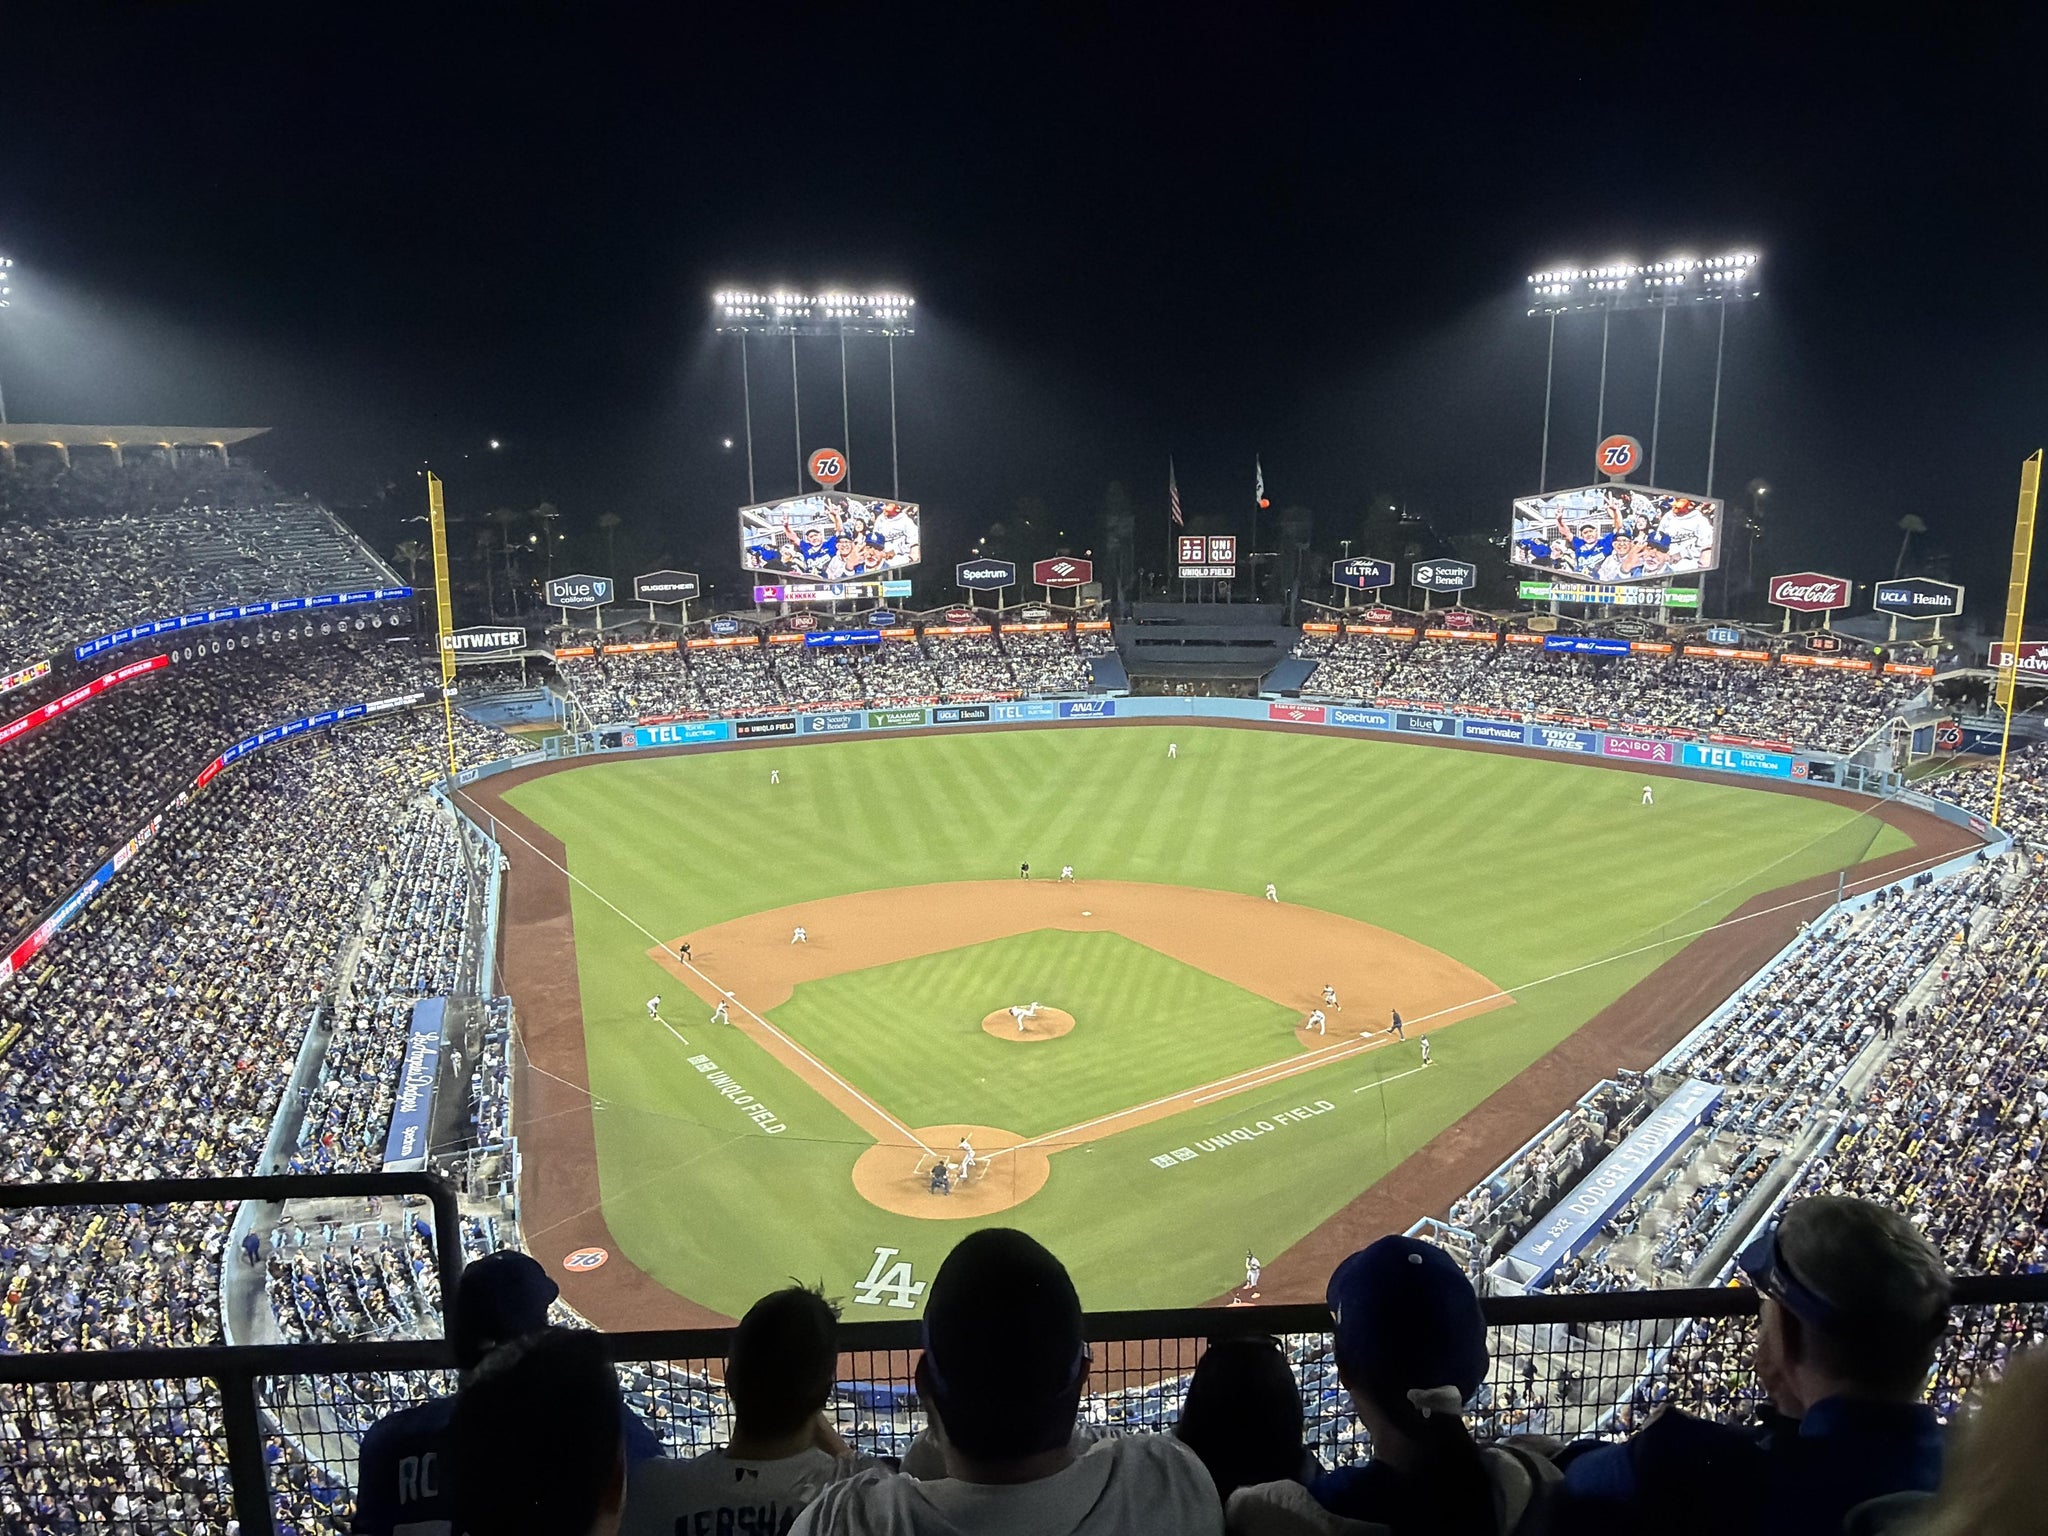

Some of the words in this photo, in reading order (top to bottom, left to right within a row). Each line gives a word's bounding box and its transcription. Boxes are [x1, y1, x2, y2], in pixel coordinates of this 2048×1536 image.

[1604, 444, 1630, 466] 76
[817, 457, 840, 476] 76
[1212, 540, 1230, 549] UNI
[1212, 551, 1232, 561] QLO
[963, 570, 1006, 580] Spectrum
[1182, 568, 1208, 576] UNIQLO
[1210, 568, 1232, 576] FIELD
[1346, 566, 1379, 576] ULTRA
[1436, 567, 1469, 578] Security
[1436, 576, 1464, 584] Benefit
[554, 582, 590, 596] blue
[641, 583, 694, 592] GUGGENHEIM
[560, 596, 595, 604] california
[1880, 592, 1907, 602] UCLA
[1913, 594, 1952, 606] Health
[443, 632, 519, 650] CUTWATER
[1710, 630, 1735, 642] TEL
[960, 710, 985, 718] Health
[998, 706, 1023, 718] TEL
[1070, 704, 1092, 712] ANA
[826, 716, 852, 725] Security
[1335, 710, 1382, 724] Spectrum
[1410, 717, 1432, 728] blue
[752, 724, 774, 732] UNIQLO
[827, 722, 850, 730] Benefit
[647, 726, 682, 742] TEL
[1466, 726, 1522, 740] smartwater
[1542, 730, 1576, 740] TOYO
[1936, 728, 1959, 744] 76
[624, 734, 635, 745] 76
[1546, 738, 1584, 750] TIRES
[1610, 739, 1650, 751] DAISO
[1697, 746, 1736, 768] TEL
[1741, 752, 1765, 761] TOKYO
[1741, 760, 1778, 770] ELECTRON
[1794, 766, 1806, 775] 76
[404, 1043, 439, 1075] Angeles
[396, 1074, 434, 1113] Dodgers
[706, 1070, 754, 1104] UNIQLO
[741, 1103, 786, 1134] FIELD
[1194, 1121, 1275, 1152] UNIQLO
[1272, 1100, 1336, 1126] FIELD
[1568, 1163, 1632, 1215] DODGER
[1622, 1114, 1679, 1164] STADIUM
[569, 1252, 603, 1267] 76
[853, 1247, 927, 1309] LA
